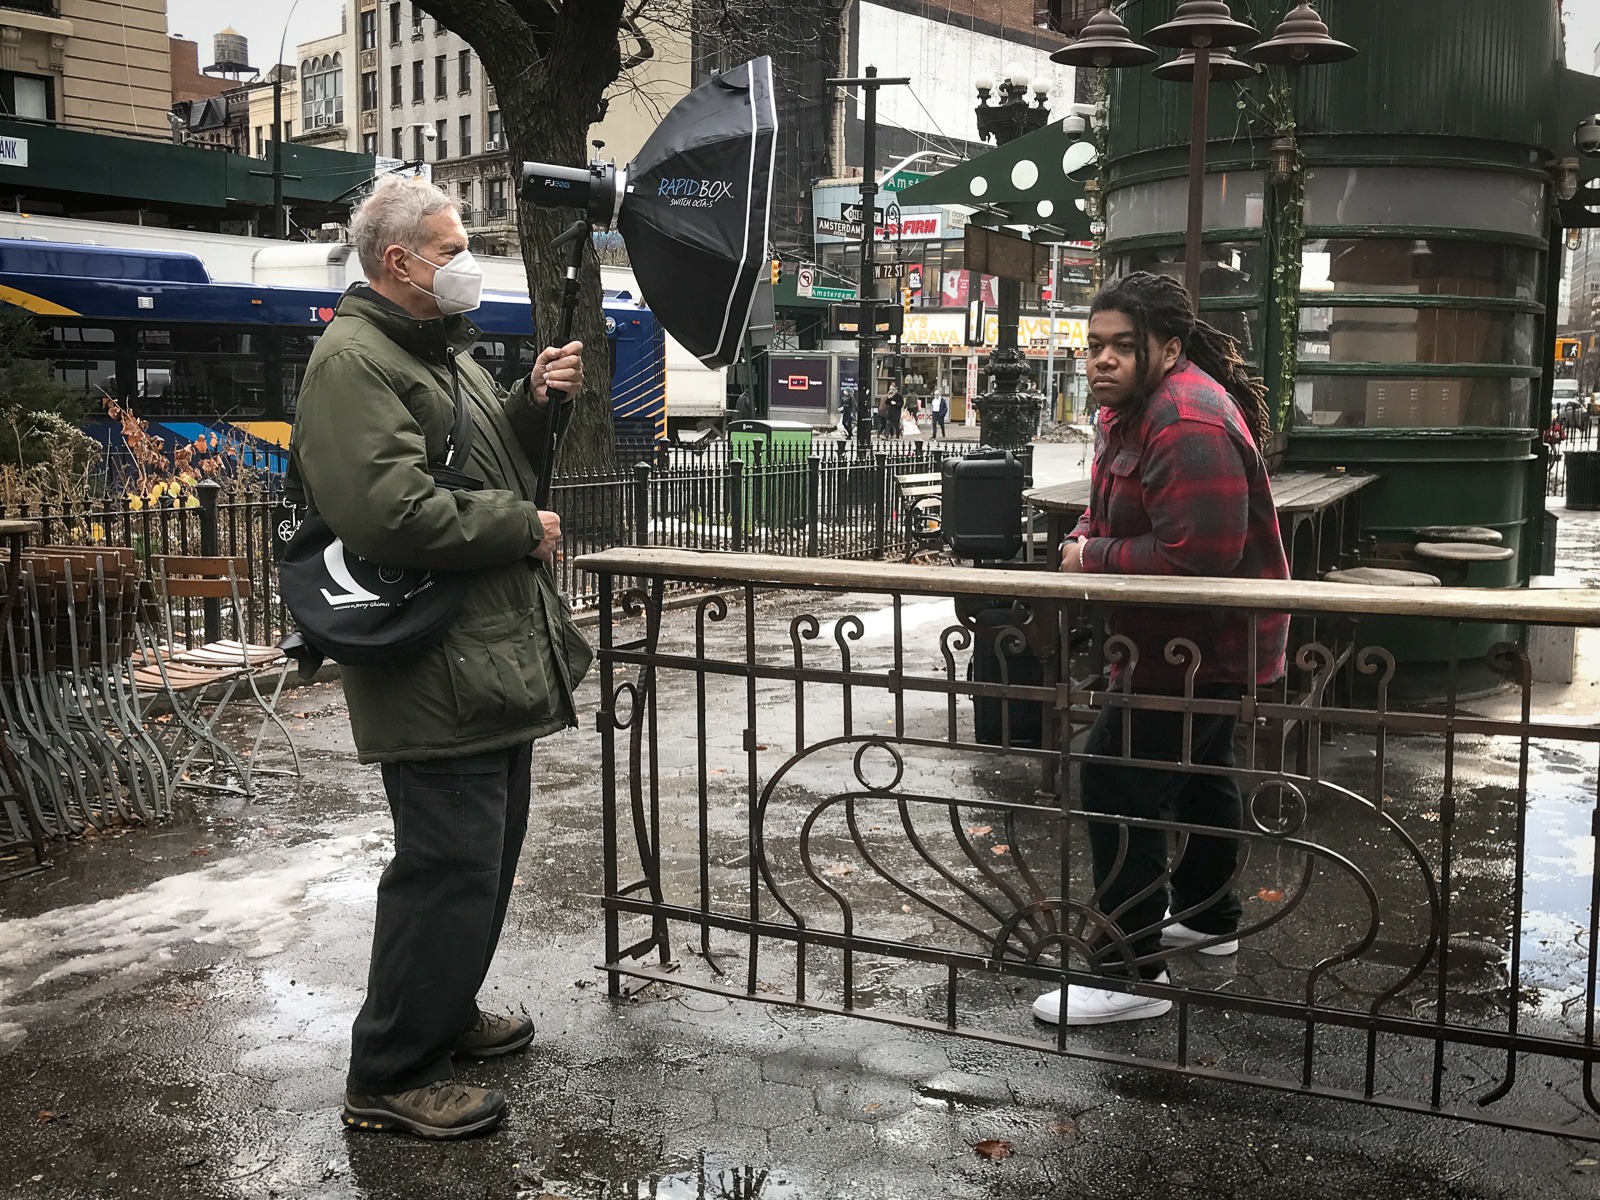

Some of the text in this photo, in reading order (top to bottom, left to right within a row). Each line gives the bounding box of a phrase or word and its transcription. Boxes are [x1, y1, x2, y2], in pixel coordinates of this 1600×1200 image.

[670, 198, 714, 208] SWITCH OCTA-S
[848, 210, 863, 221] ONE
[818, 220, 861, 235] AMSTERDAM
[875, 264, 904, 278] W 72 ST
[812, 289, 852, 299] Amsterdam
[309, 306, 318, 322] I
[985, 316, 1050, 345] GAY'S
